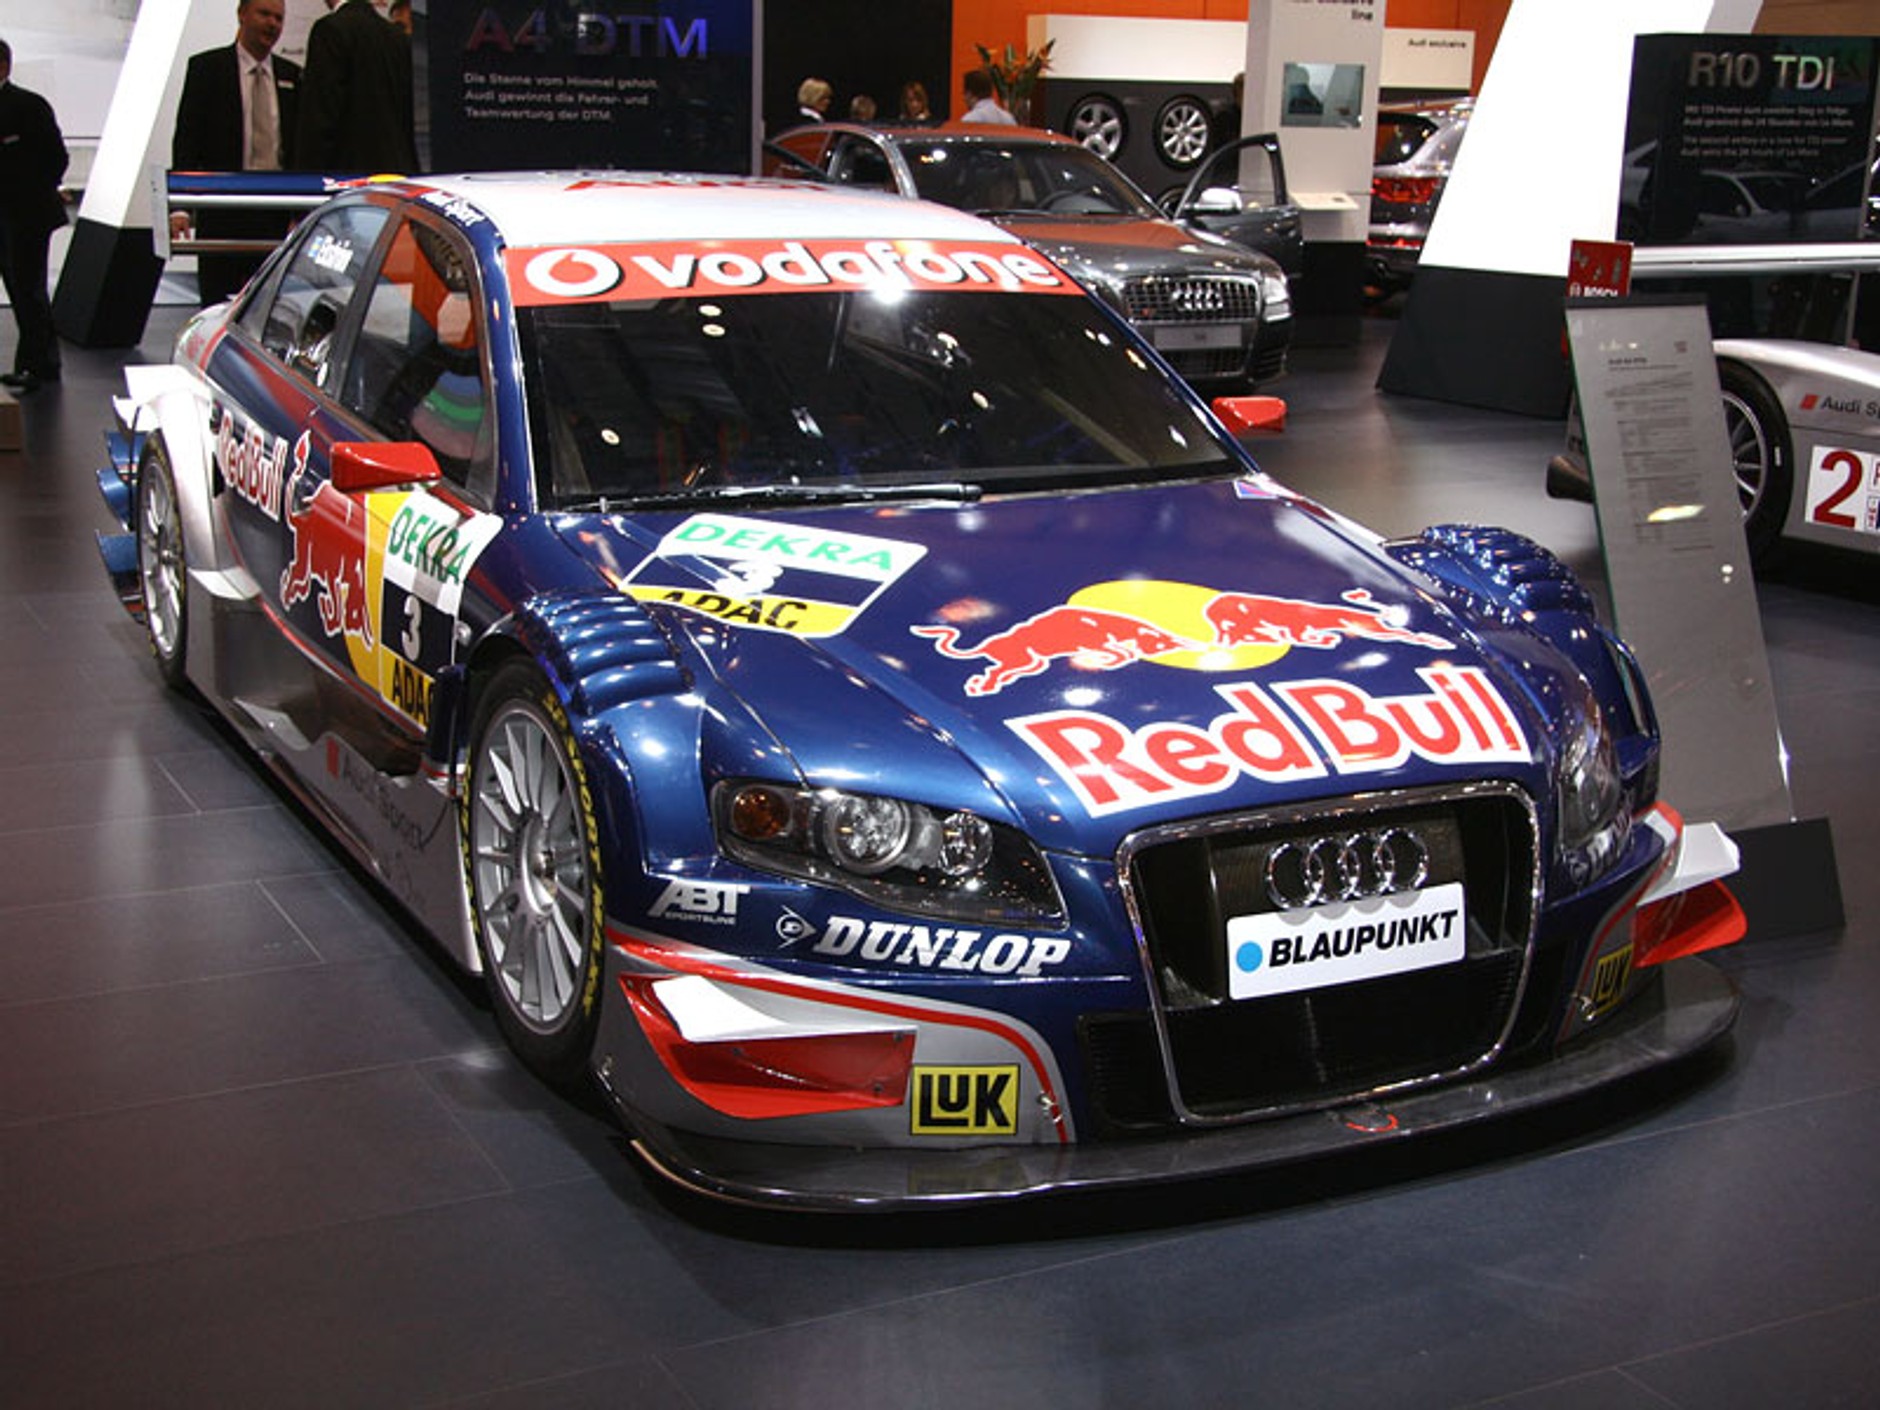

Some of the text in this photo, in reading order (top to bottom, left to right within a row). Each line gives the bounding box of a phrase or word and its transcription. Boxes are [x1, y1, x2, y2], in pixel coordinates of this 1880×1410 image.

[467, 7, 708, 58] A4 DTM
[1351, 10, 1374, 21] line
[1687, 51, 1835, 91] R10 TDI
[464, 90, 495, 102] Audi
[498, 92, 552, 105] gewinnt
[555, 92, 574, 103] die
[624, 94, 649, 106] und
[465, 106, 556, 122] Teamwertung
[557, 108, 579, 120] der
[630, 241, 1064, 293] vodafone
[1820, 395, 1880, 422] Audi S
[1812, 450, 1863, 528] 2
[389, 506, 475, 586] DEKRA
[674, 521, 892, 571] DEKRA
[402, 594, 424, 661] 3
[1020, 671, 1524, 806] Red Bull
[647, 879, 751, 918] ABT
[812, 916, 1071, 976] DUNLOP
[1268, 908, 1459, 968] BLAUPUNKT
